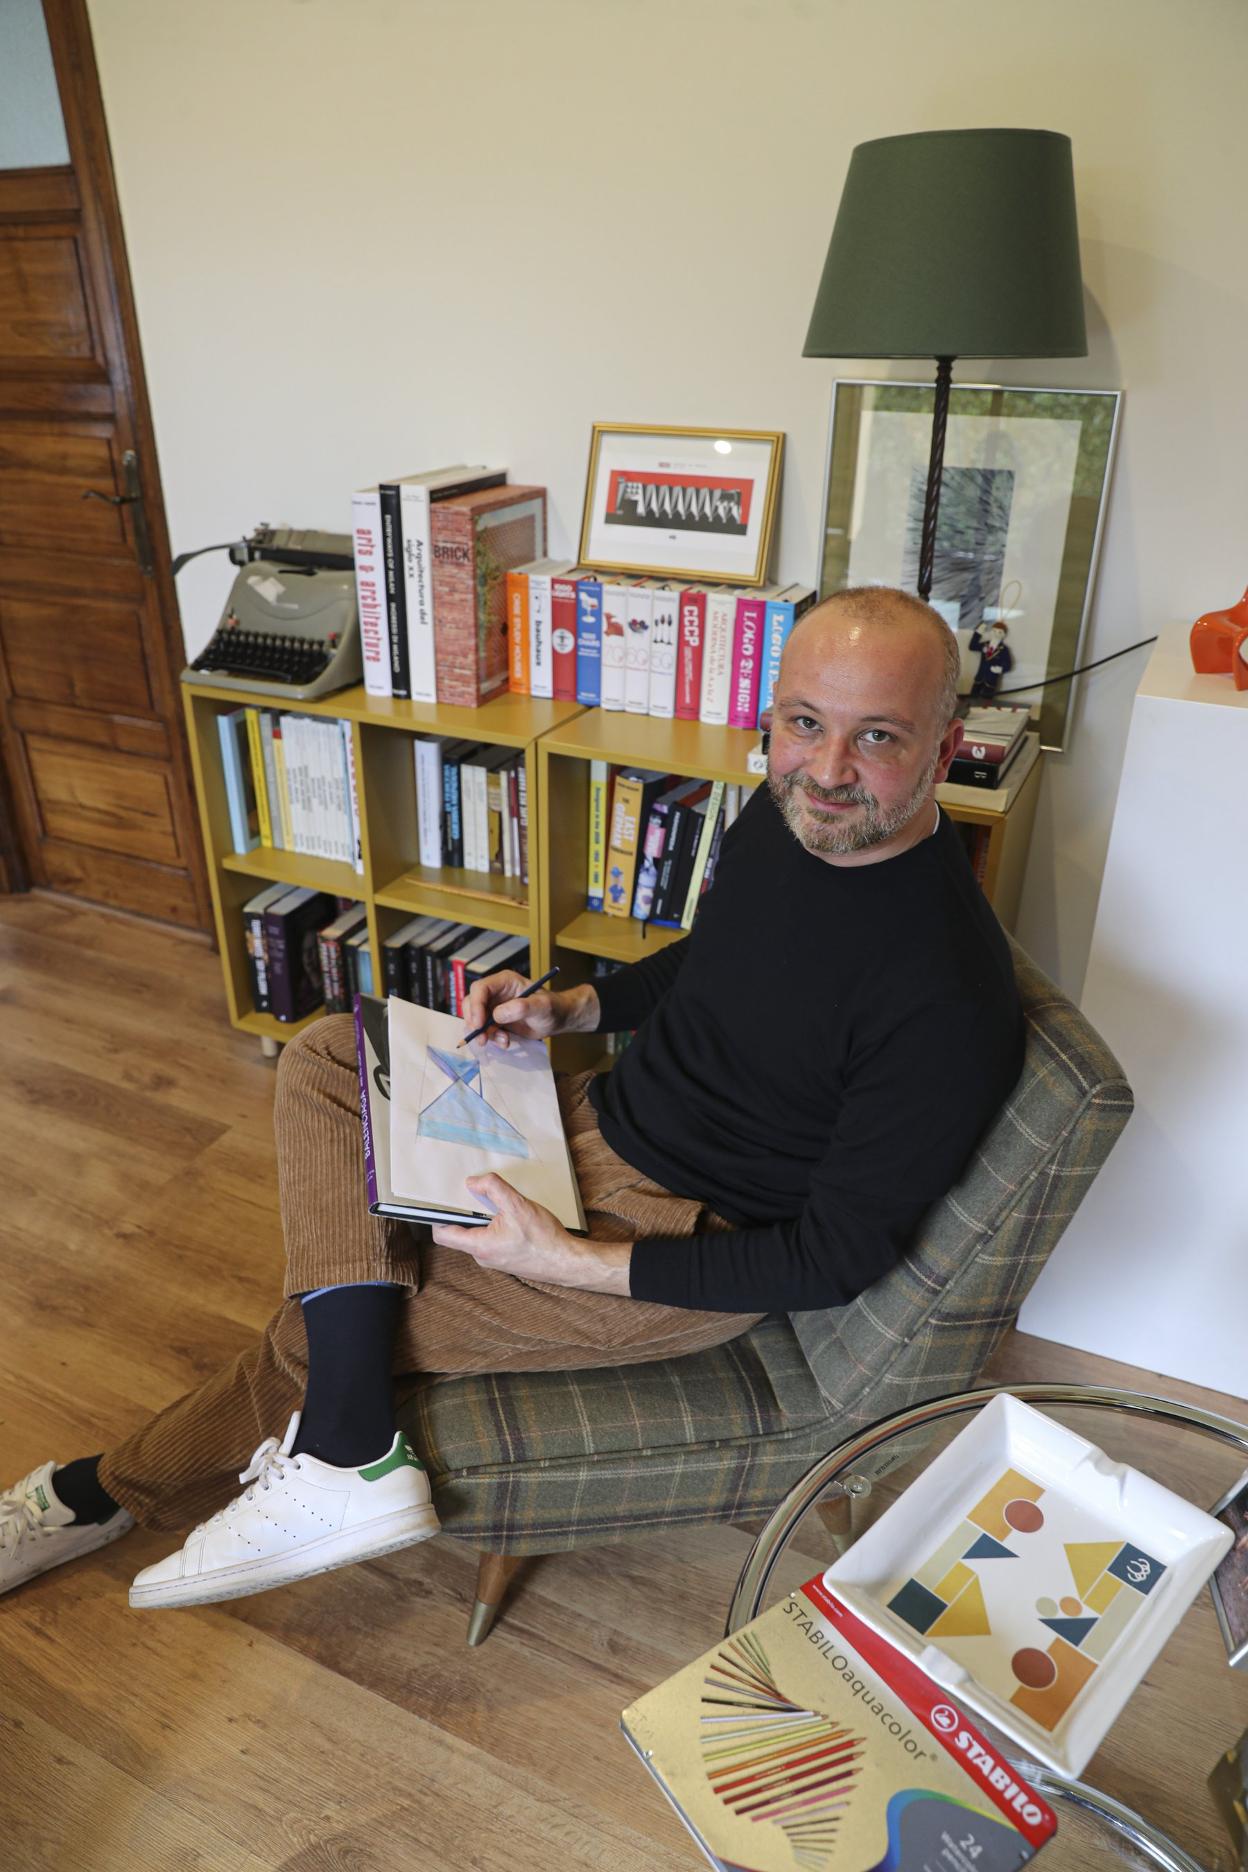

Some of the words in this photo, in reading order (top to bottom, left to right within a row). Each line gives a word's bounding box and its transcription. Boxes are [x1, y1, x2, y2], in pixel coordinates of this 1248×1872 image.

[356, 528, 375, 557] arts
[384, 514, 395, 558] ENTRYWAYS
[405, 539, 414, 562] siglo
[433, 544, 471, 562] BRICK
[359, 564, 375, 574] &
[387, 570, 397, 595] MILAN
[416, 539, 427, 607] Arquitectura
[360, 580, 382, 663] architecture
[419, 608, 428, 625] del
[513, 616, 523, 643] STUDY
[683, 605, 699, 647] CCCP
[741, 611, 757, 656] LOGO
[771, 613, 785, 658] LOGO
[392, 643, 401, 673] MILANO
[514, 645, 523, 679] HOUSES
[535, 620, 543, 667] bauhaus
[737, 657, 754, 713] DESIGN
[611, 802, 625, 848] GERMAN
[624, 815, 636, 842] EAST
[361, 1089, 371, 1160] BALENCIAGA
[953, 1730, 1045, 1827] STABILO
[959, 1833, 984, 1860] 24
